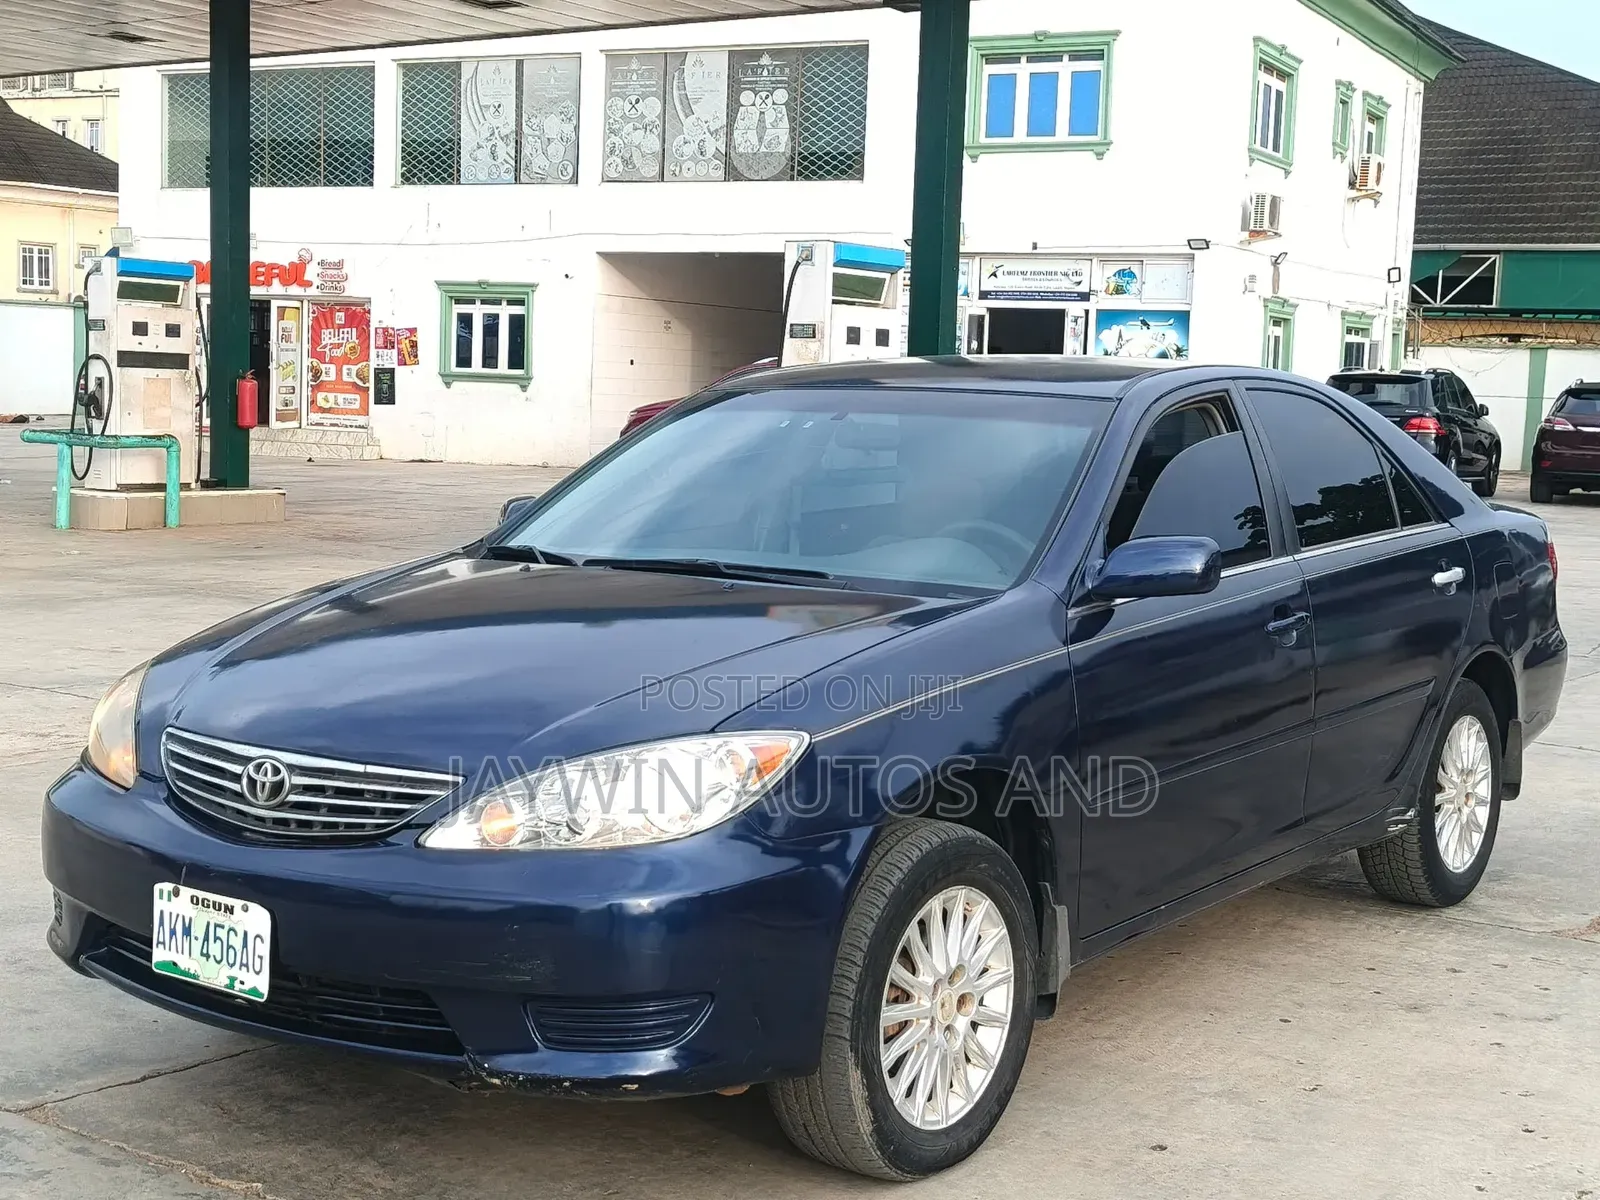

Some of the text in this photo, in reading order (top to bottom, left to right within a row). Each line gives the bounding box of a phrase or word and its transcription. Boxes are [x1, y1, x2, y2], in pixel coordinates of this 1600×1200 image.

[320, 259, 342, 268] Bread
[320, 272, 345, 281] Snacks
[319, 284, 343, 292] Drinks
[281, 334, 293, 344] FUL
[190, 894, 235, 916] OGUN
